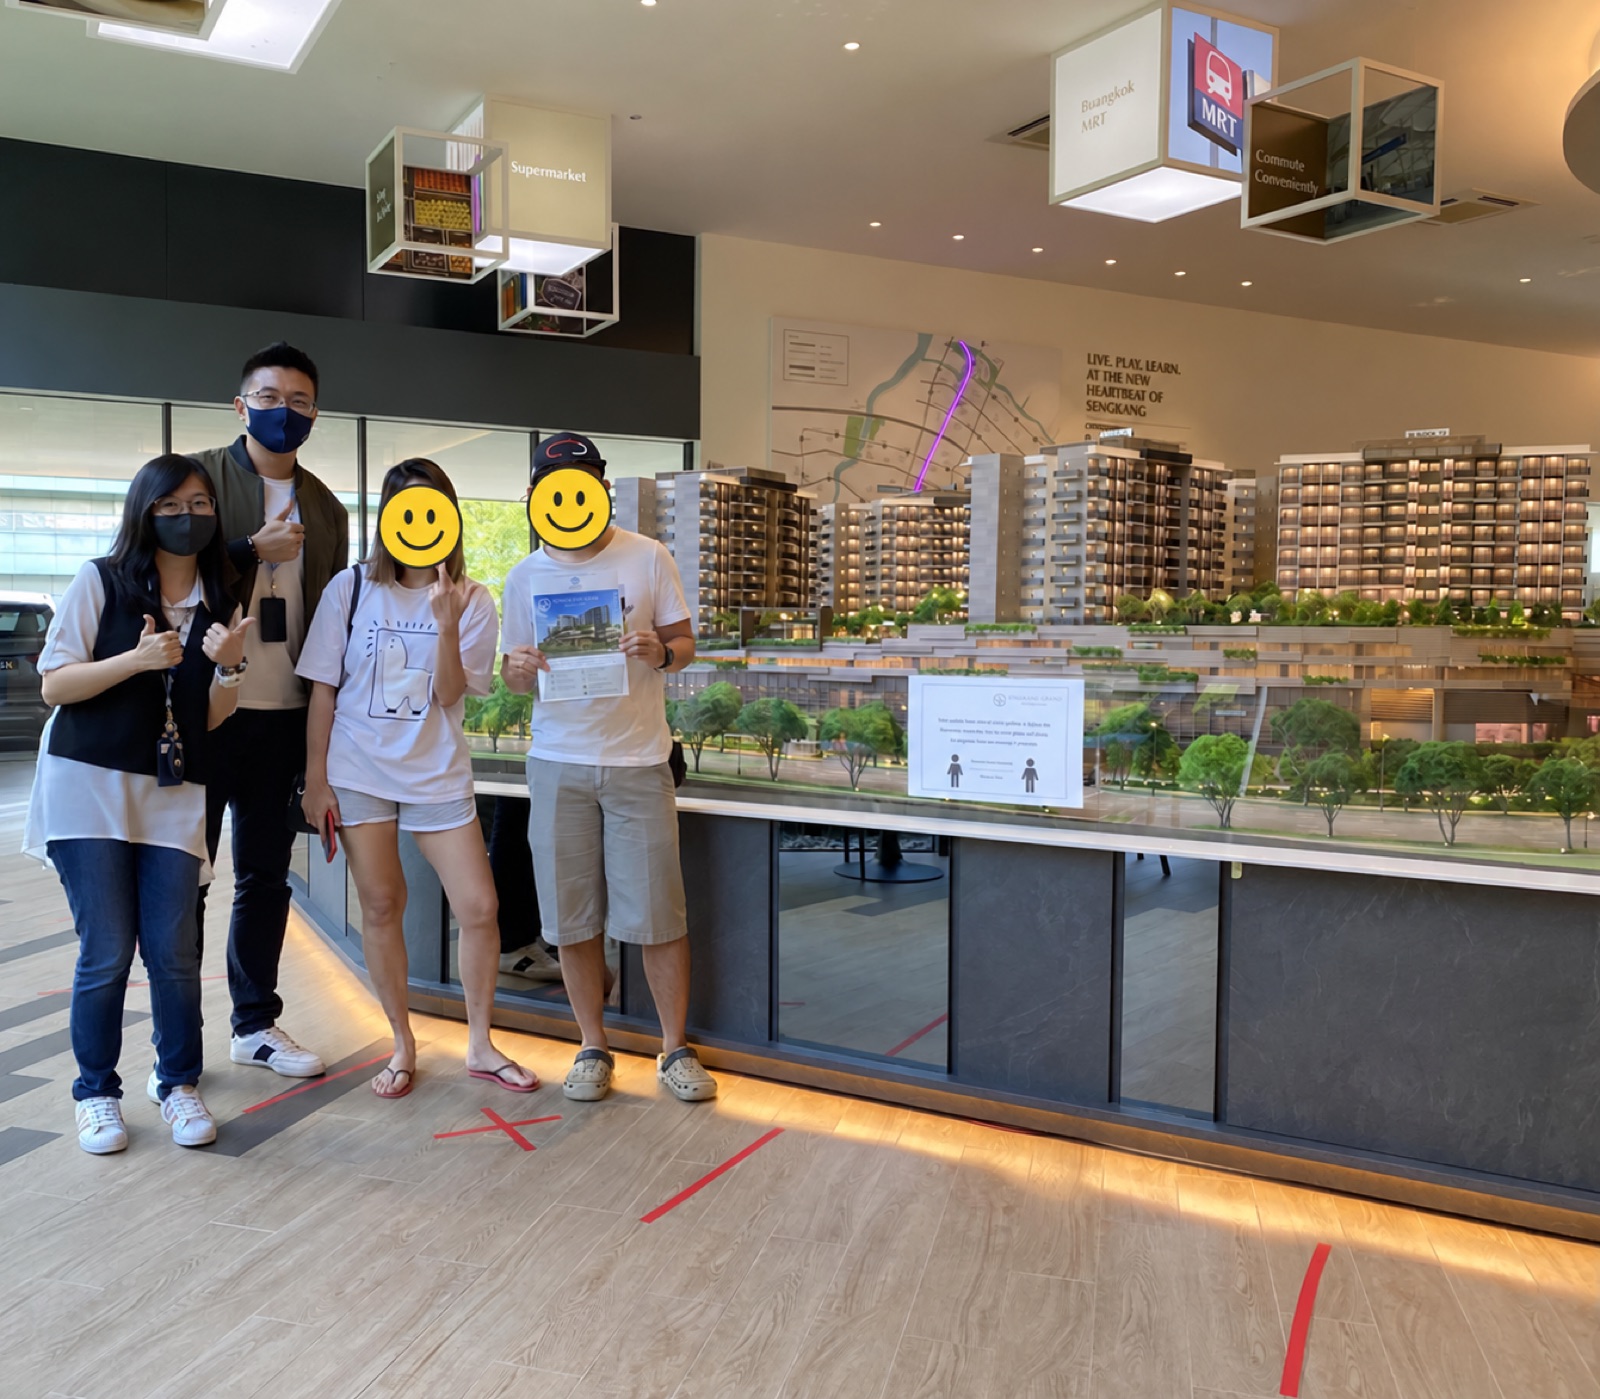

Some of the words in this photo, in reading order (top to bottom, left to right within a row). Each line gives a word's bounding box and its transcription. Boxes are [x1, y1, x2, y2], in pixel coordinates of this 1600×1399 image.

[1081, 80, 1135, 113] Buangkok
[1081, 111, 1107, 133] MRT
[1202, 97, 1237, 138] MRT
[511, 160, 587, 182] Supermarket
[1255, 149, 1305, 172] Commute
[1254, 168, 1319, 199] Conveniently
[1087, 353, 1112, 367] LIVE.
[1116, 356, 1143, 371] PLAY.
[1146, 360, 1181, 375] LEARN.
[1086, 369, 1099, 381] AT
[1103, 371, 1123, 384] THE
[1125, 373, 1151, 386] NEW
[1086, 384, 1147, 401] HEARTBEAT
[1149, 390, 1163, 403] OF
[1086, 400, 1147, 417] SENGKANG
